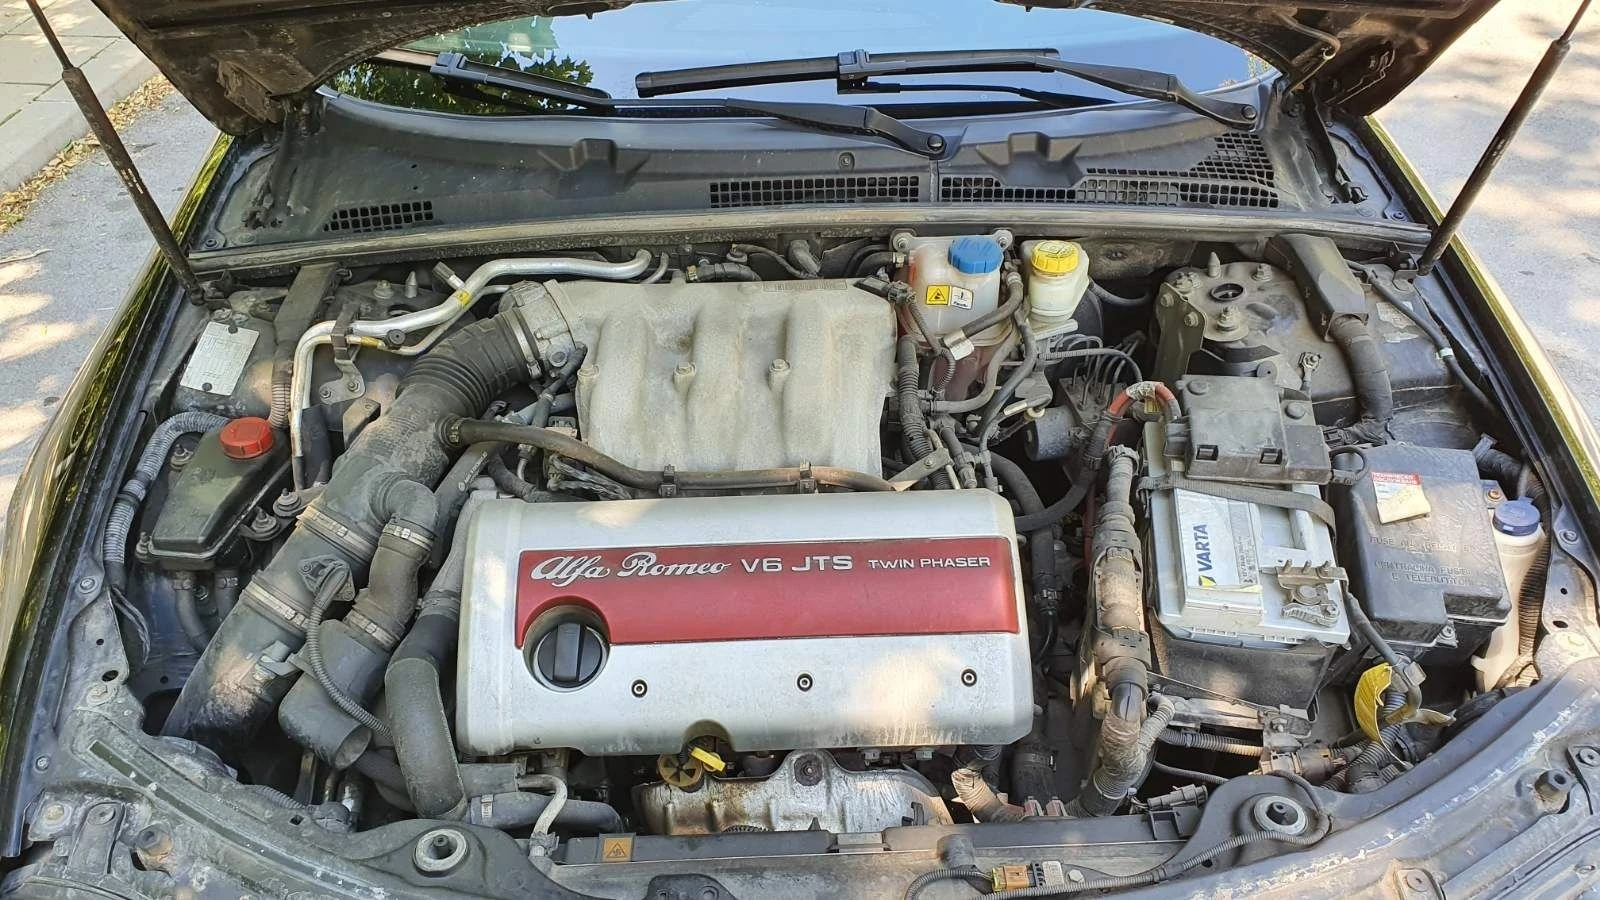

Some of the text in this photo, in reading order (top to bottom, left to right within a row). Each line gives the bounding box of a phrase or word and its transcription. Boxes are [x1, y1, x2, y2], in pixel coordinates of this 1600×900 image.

[1193, 524, 1213, 572] VARTA
[531, 551, 991, 588] Alfa Romeo V6 JTS TWIN PHASER
